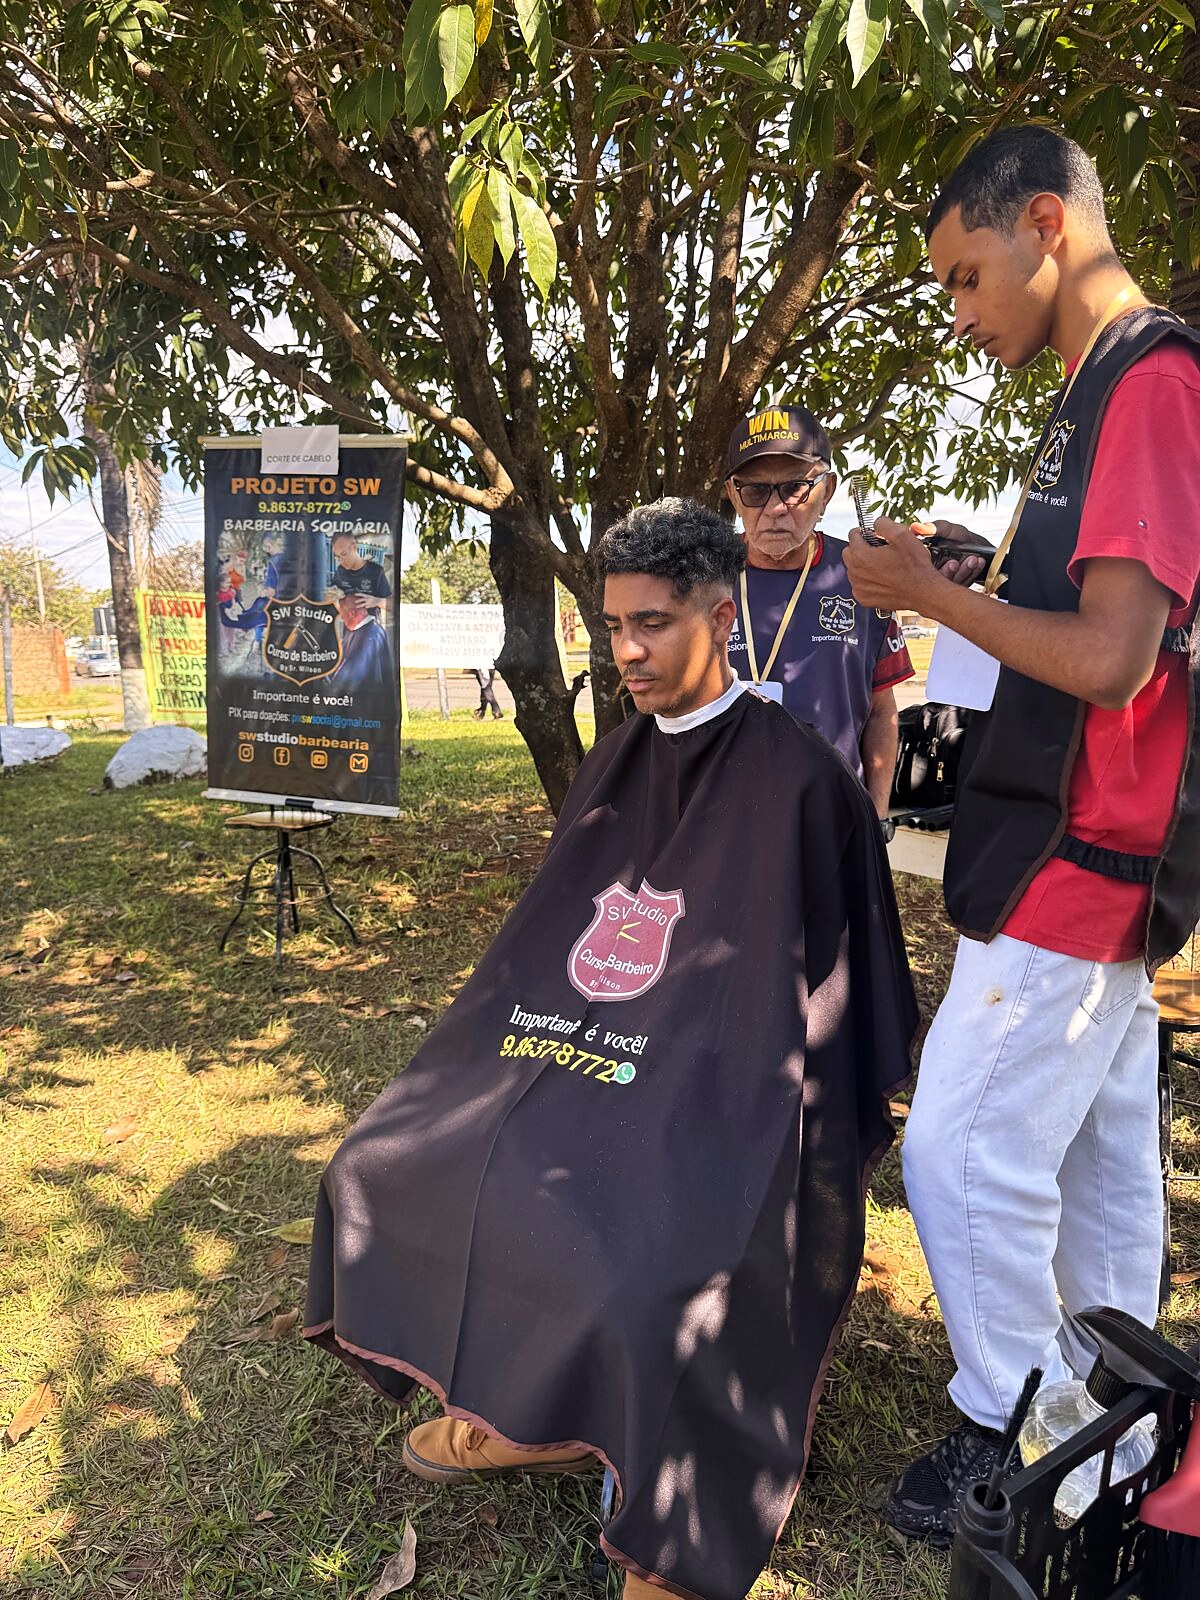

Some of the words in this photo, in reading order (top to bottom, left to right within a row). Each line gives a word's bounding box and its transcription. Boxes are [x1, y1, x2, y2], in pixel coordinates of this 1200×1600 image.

[749, 410, 790, 436] WIN
[739, 431, 800, 452] MULTIMARCAS
[266, 454, 290, 463] CORTE
[291, 454, 301, 463] DE
[302, 453, 332, 463] CABELO
[231, 477, 337, 495] PROJETO
[343, 477, 381, 496] SW
[258, 501, 342, 514] 9.8637-8772
[1044, 493, 1049, 504] é
[1050, 495, 1067, 507] você!
[223, 518, 305, 532] BARBEARIA
[310, 518, 391, 534] SOLIDÁRIA
[272, 607, 291, 620] SW
[294, 606, 333, 624] Studio
[267, 644, 289, 660] Curso
[290, 650, 300, 661] de
[301, 650, 337, 662] Barbeiro
[280, 664, 288, 672] By
[299, 665, 322, 673] Wilson
[252, 690, 310, 703] Importante
[313, 693, 320, 705] é
[323, 695, 353, 707] você!
[228, 706, 242, 717] PIX
[243, 710, 258, 720] para
[259, 710, 291, 723] doações:
[238, 731, 369, 751] swstudiobarbearia
[632, 898, 668, 926] tudio
[580, 948, 607, 971] Curso
[605, 953, 654, 976] Barbeiro
[585, 1023, 600, 1042] é
[604, 1031, 649, 1056] você!
[499, 1034, 618, 1084] 9.8637-8772
